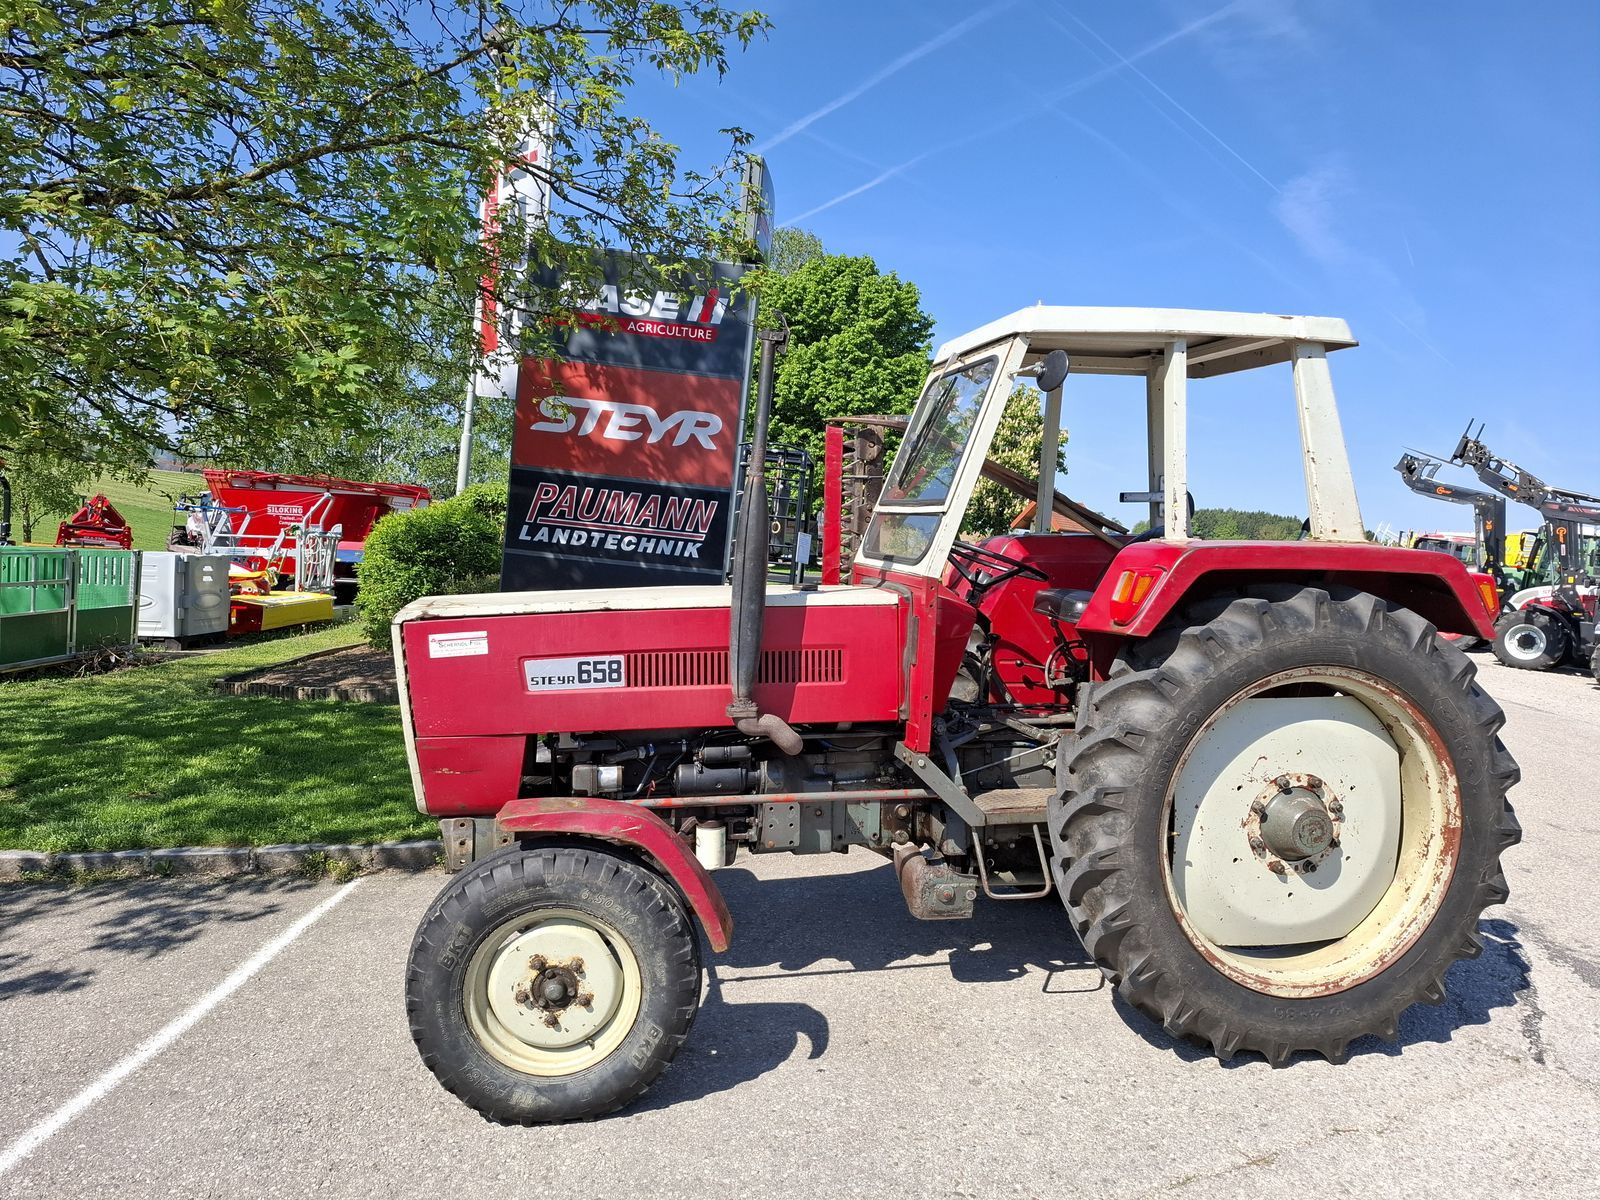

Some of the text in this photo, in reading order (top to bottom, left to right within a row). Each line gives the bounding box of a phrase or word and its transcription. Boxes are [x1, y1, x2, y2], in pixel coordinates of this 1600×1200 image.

[627, 322, 712, 340] AGRICULTURE
[530, 396, 723, 450] STEYR
[267, 506, 303, 514] SILOKING
[525, 482, 719, 533] PAUMANN
[518, 525, 703, 559] LANDTECHNIK
[531, 660, 622, 686] STEYR 658
[439, 922, 474, 971] BKT
[630, 1022, 664, 1070] BKT
